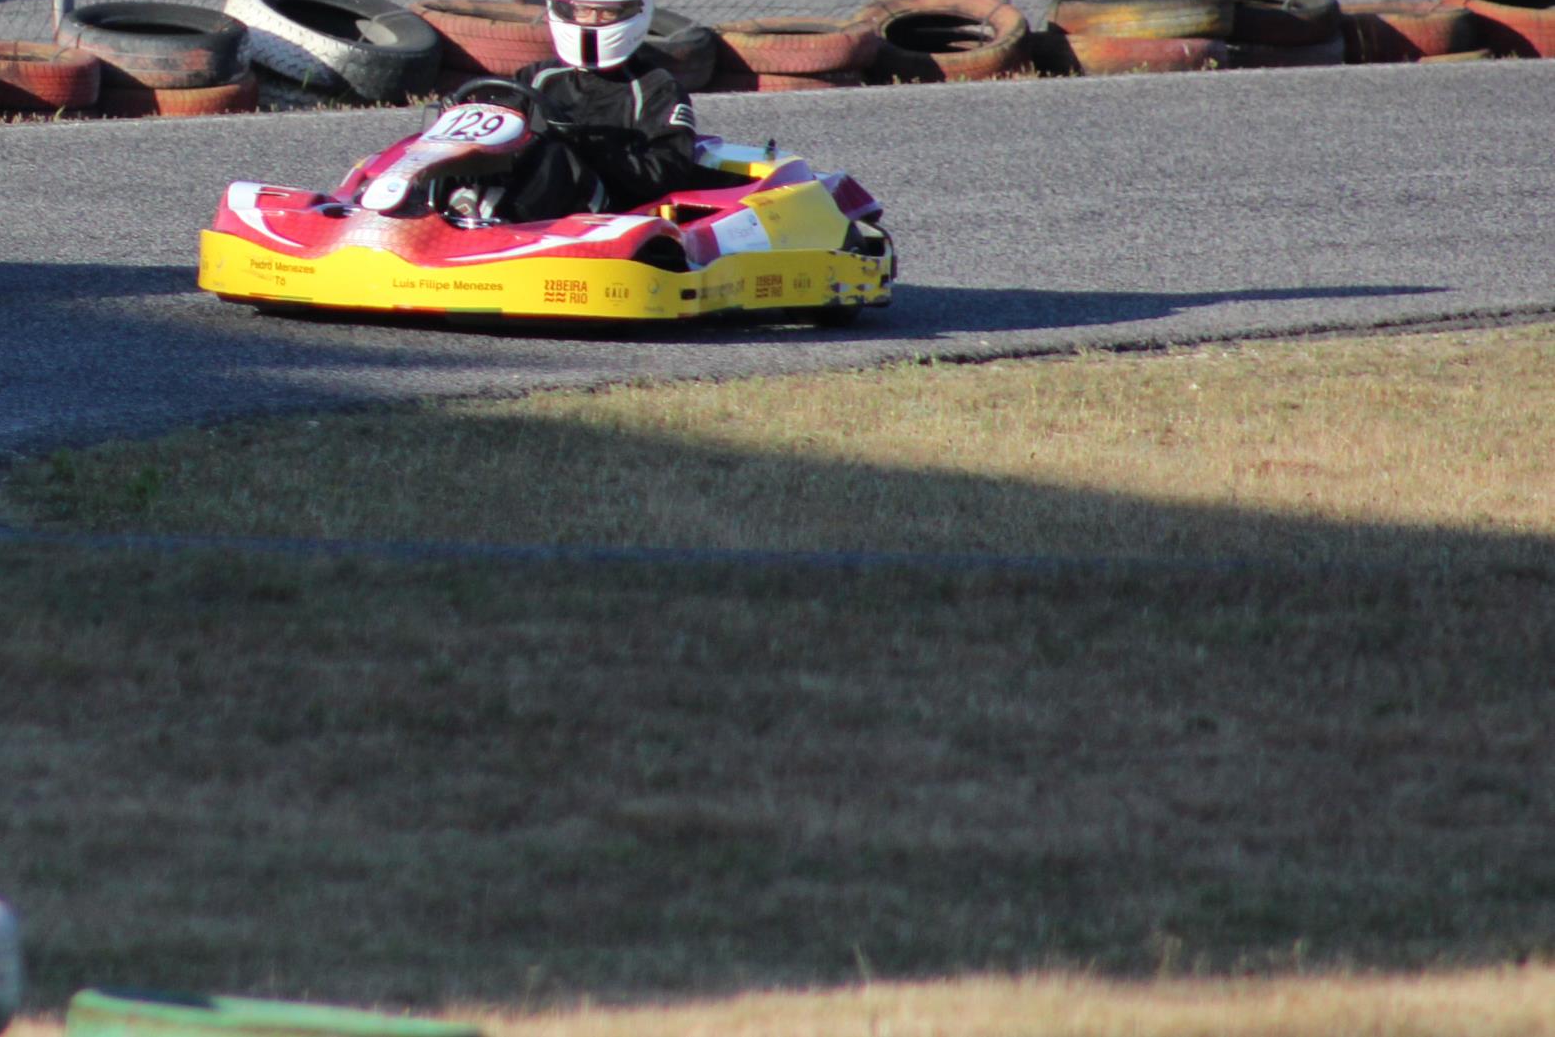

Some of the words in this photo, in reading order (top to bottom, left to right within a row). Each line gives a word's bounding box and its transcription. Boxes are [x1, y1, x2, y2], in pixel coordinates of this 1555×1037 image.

[443, 110, 505, 137] 129
[274, 261, 315, 274] Menezes
[392, 278, 416, 289] Luis
[419, 279, 450, 291] Filipe
[453, 280, 504, 291] Menezes
[556, 279, 588, 292] BEIRA
[569, 292, 588, 304] RIO
